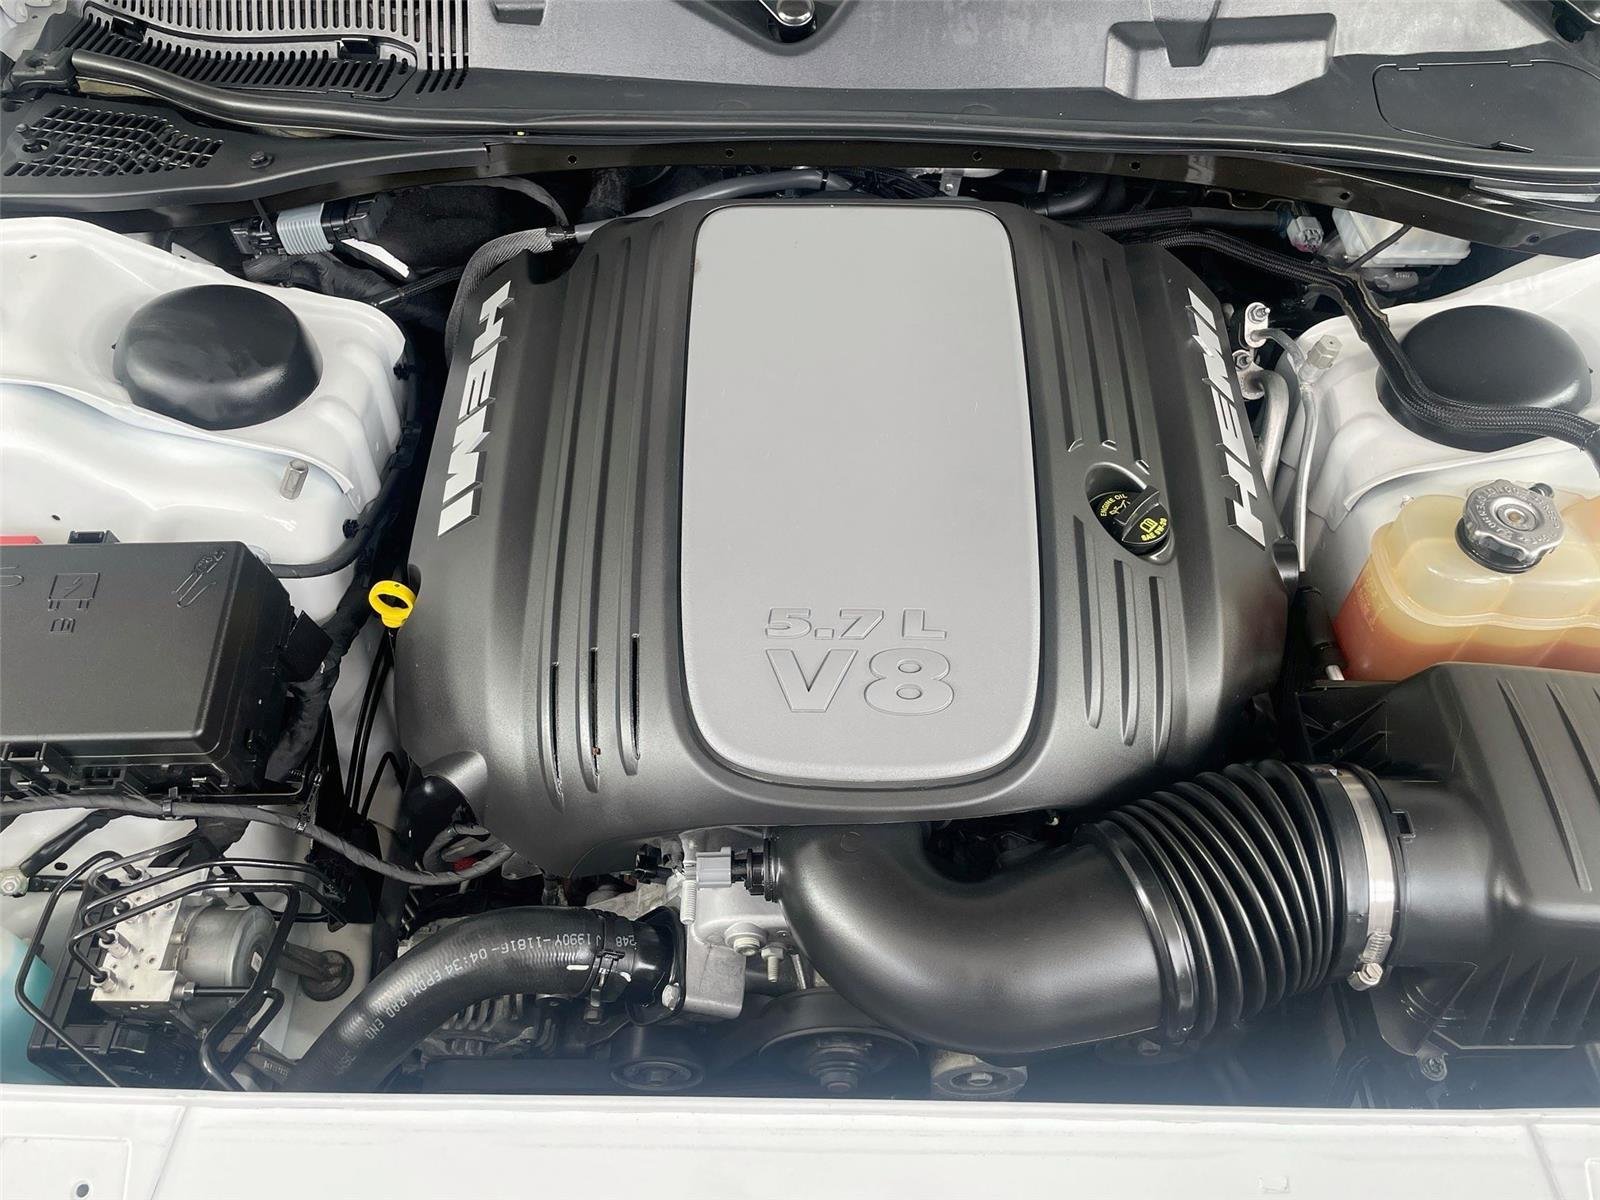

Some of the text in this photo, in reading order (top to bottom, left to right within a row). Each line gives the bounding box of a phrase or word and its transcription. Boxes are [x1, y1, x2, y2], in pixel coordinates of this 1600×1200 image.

[437, 280, 513, 537] HEMI
[1186, 287, 1266, 550] HEMI
[1100, 493, 1128, 517] ENGINE OIL
[765, 647, 955, 716] V8
[444, 947, 488, 976] 04:34
[409, 970, 442, 998] EPDM
[385, 994, 408, 1018] RAD
[364, 1017, 385, 1040] END
